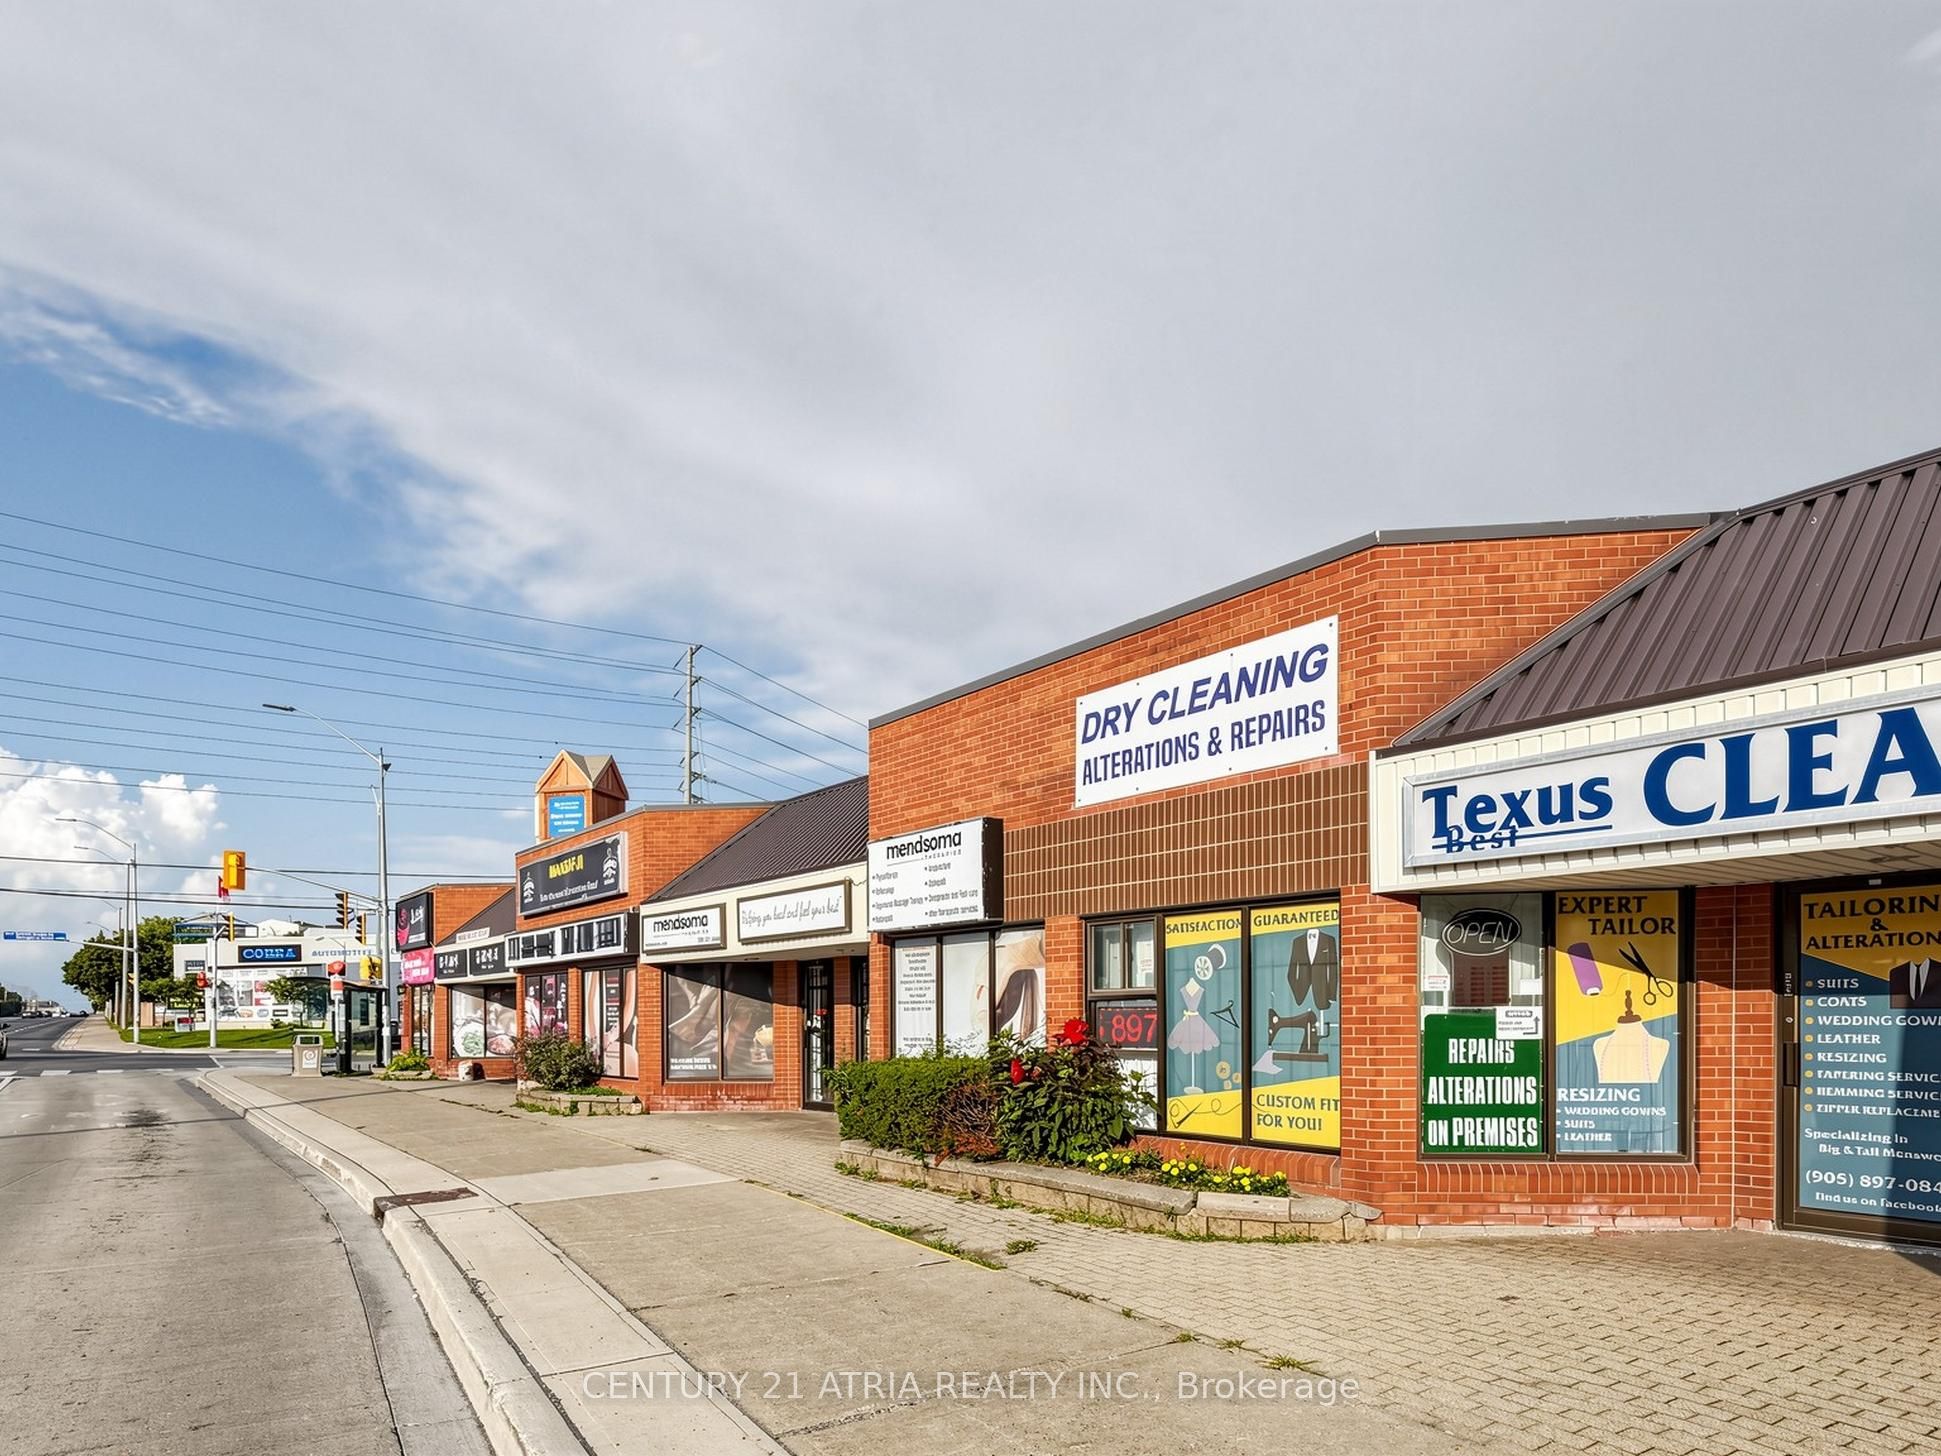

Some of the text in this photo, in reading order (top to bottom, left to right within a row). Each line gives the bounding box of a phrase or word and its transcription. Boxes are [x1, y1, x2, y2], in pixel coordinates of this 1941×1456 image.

[1081, 643, 1329, 744] DRY CLEANING
[1082, 699, 1325, 785] ALTERATIONS & REPAIRS
[1422, 707, 1941, 839] Texus CLEA
[886, 832, 962, 860] mendsoma
[1446, 824, 1519, 854] Best
[1558, 896, 1648, 914] EXPERT
[653, 913, 708, 933] mendsoma
[1254, 909, 1339, 927] GUARANTEED
[1588, 917, 1677, 935] TAILOR
[1870, 917, 1888, 931] &
[1447, 921, 1513, 944] OPEN
[1817, 978, 1859, 989] SUITS
[1817, 996, 1867, 1007] COATS
[1818, 1015, 1892, 1026] WEDDING
[1817, 1034, 1881, 1044] LEATHER
[1448, 1038, 1515, 1064] REPAIRS
[1817, 1052, 1887, 1063] RESIZING
[1427, 1076, 1537, 1105] ALTERATIONS
[1557, 1088, 1641, 1102] RESIZING
[1817, 1087, 1885, 1098] HEMMING
[1256, 1094, 1340, 1112] CUSTOM FIT
[1564, 1107, 1666, 1116] WEDDING GOWNS
[1256, 1113, 1322, 1131] FOR YOU!
[1564, 1119, 1595, 1128] SUITS
[1428, 1117, 1538, 1147] ON PREMISES
[1564, 1132, 1612, 1142] LEATHER
[1804, 1128, 1892, 1144] Specializing
[1819, 1144, 1841, 1156] Big
[1843, 1145, 1854, 1155] &
[1855, 1146, 1879, 1157] Tall
[1806, 1170, 1854, 1188] (905)
[1843, 1196, 1858, 1205] us
[1860, 1198, 1877, 1207] on
